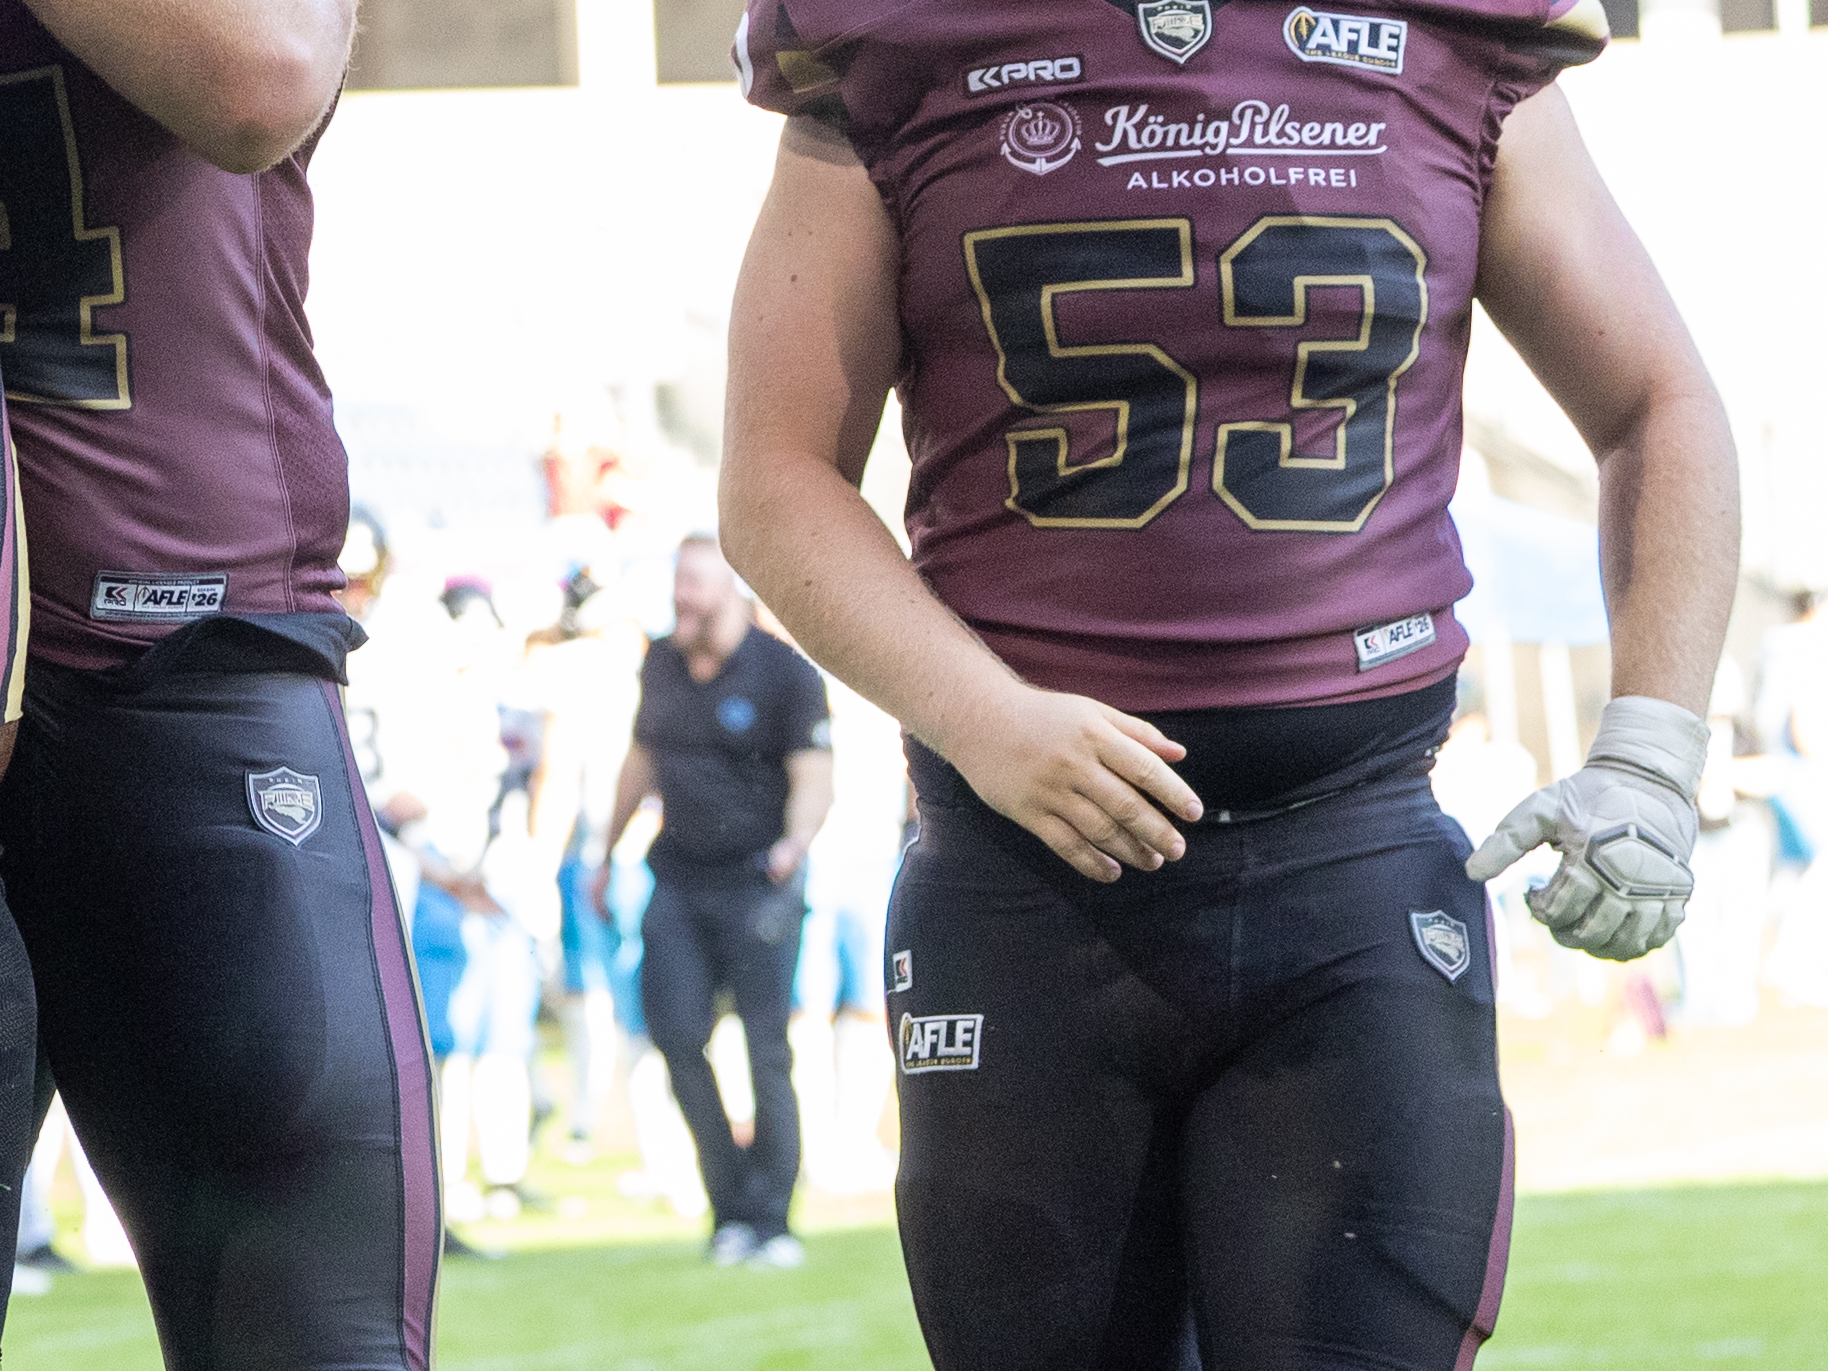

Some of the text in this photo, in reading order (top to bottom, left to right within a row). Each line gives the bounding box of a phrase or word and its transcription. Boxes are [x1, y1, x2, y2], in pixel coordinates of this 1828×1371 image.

[1305, 16, 1402, 61] AFLE
[1126, 165, 1358, 191] ALKOHOLFREI
[963, 217, 1430, 533] 53
[142, 589, 189, 606] AFLE
[906, 1020, 975, 1060] AFLE
